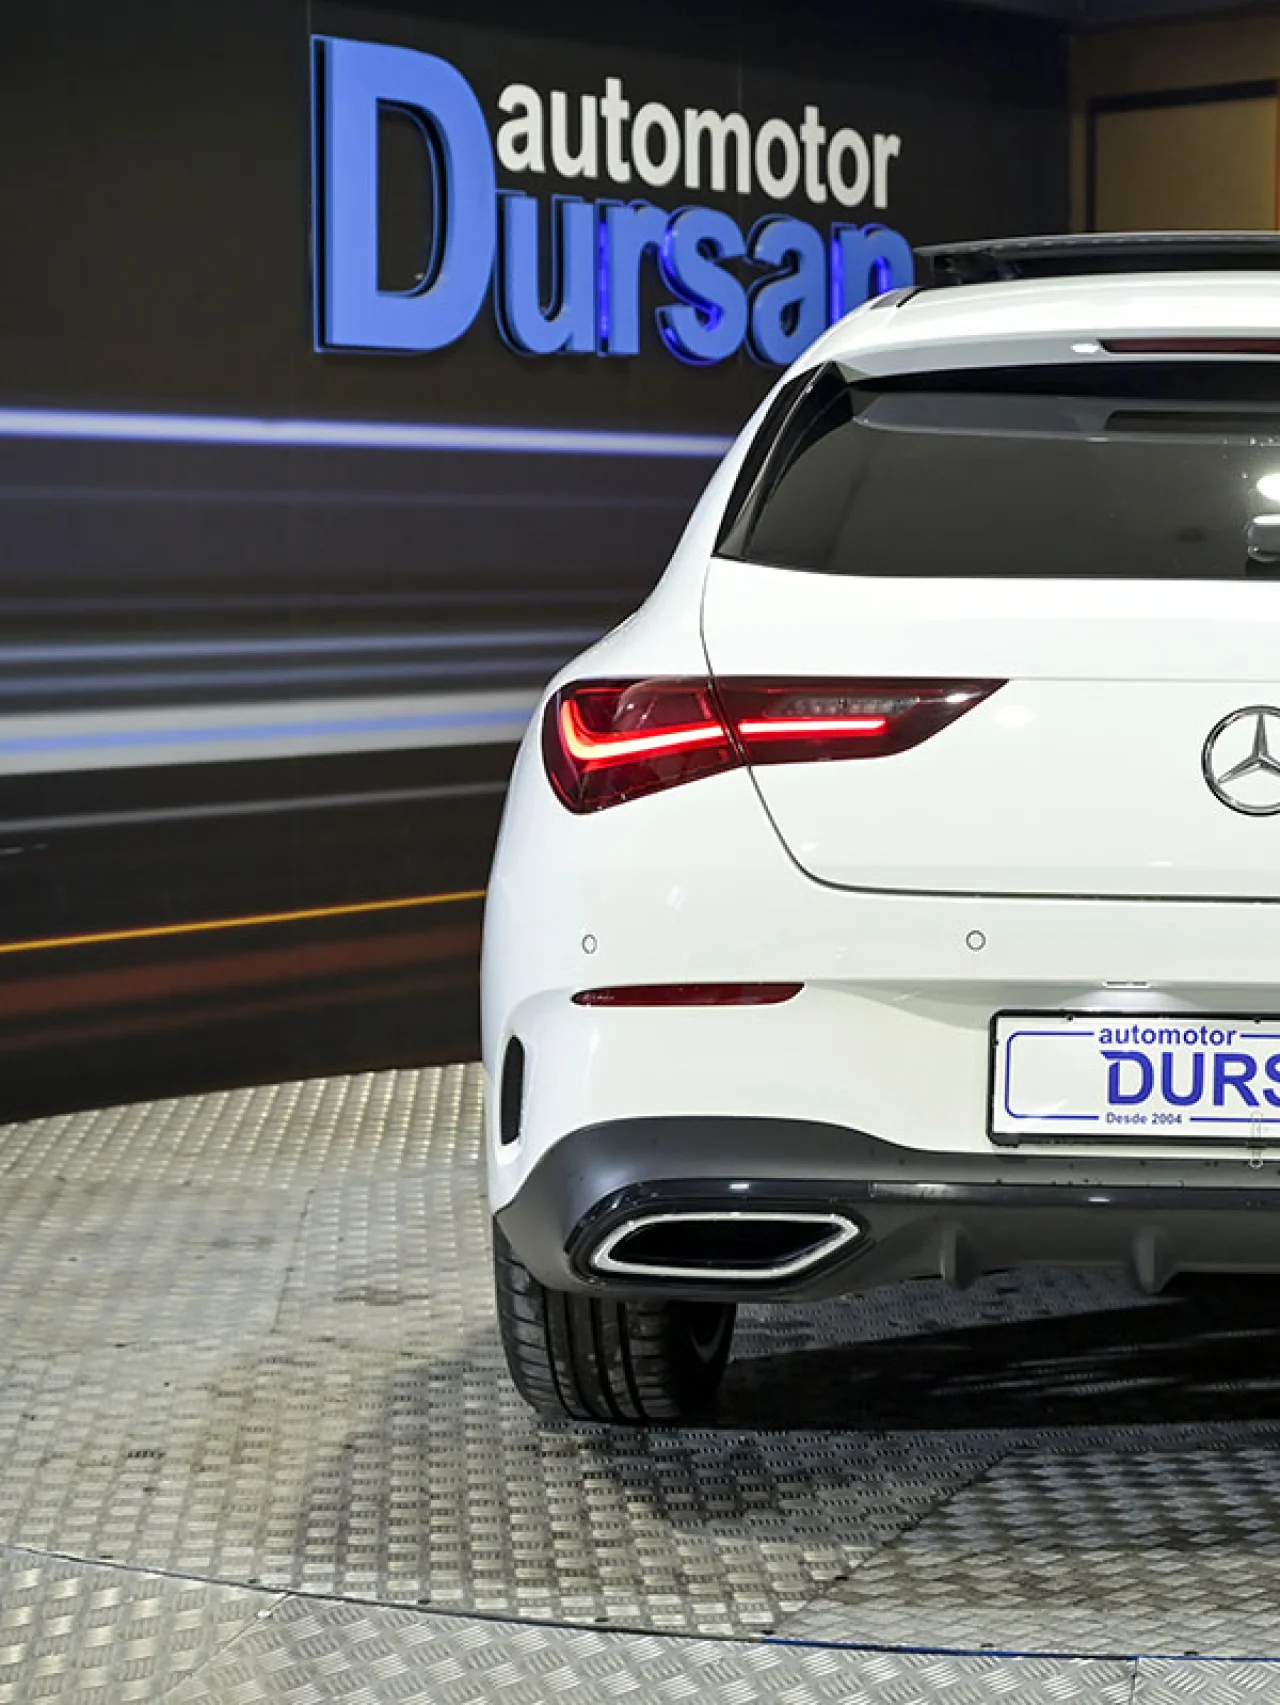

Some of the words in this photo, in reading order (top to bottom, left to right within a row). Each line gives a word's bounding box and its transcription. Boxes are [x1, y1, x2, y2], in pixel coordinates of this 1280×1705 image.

[497, 76, 900, 208] automotor
[311, 34, 913, 366] Dursan
[1099, 1025, 1236, 1046] automotor
[1106, 1112, 1147, 1125] Desde
[1151, 1113, 1183, 1125] 2004
